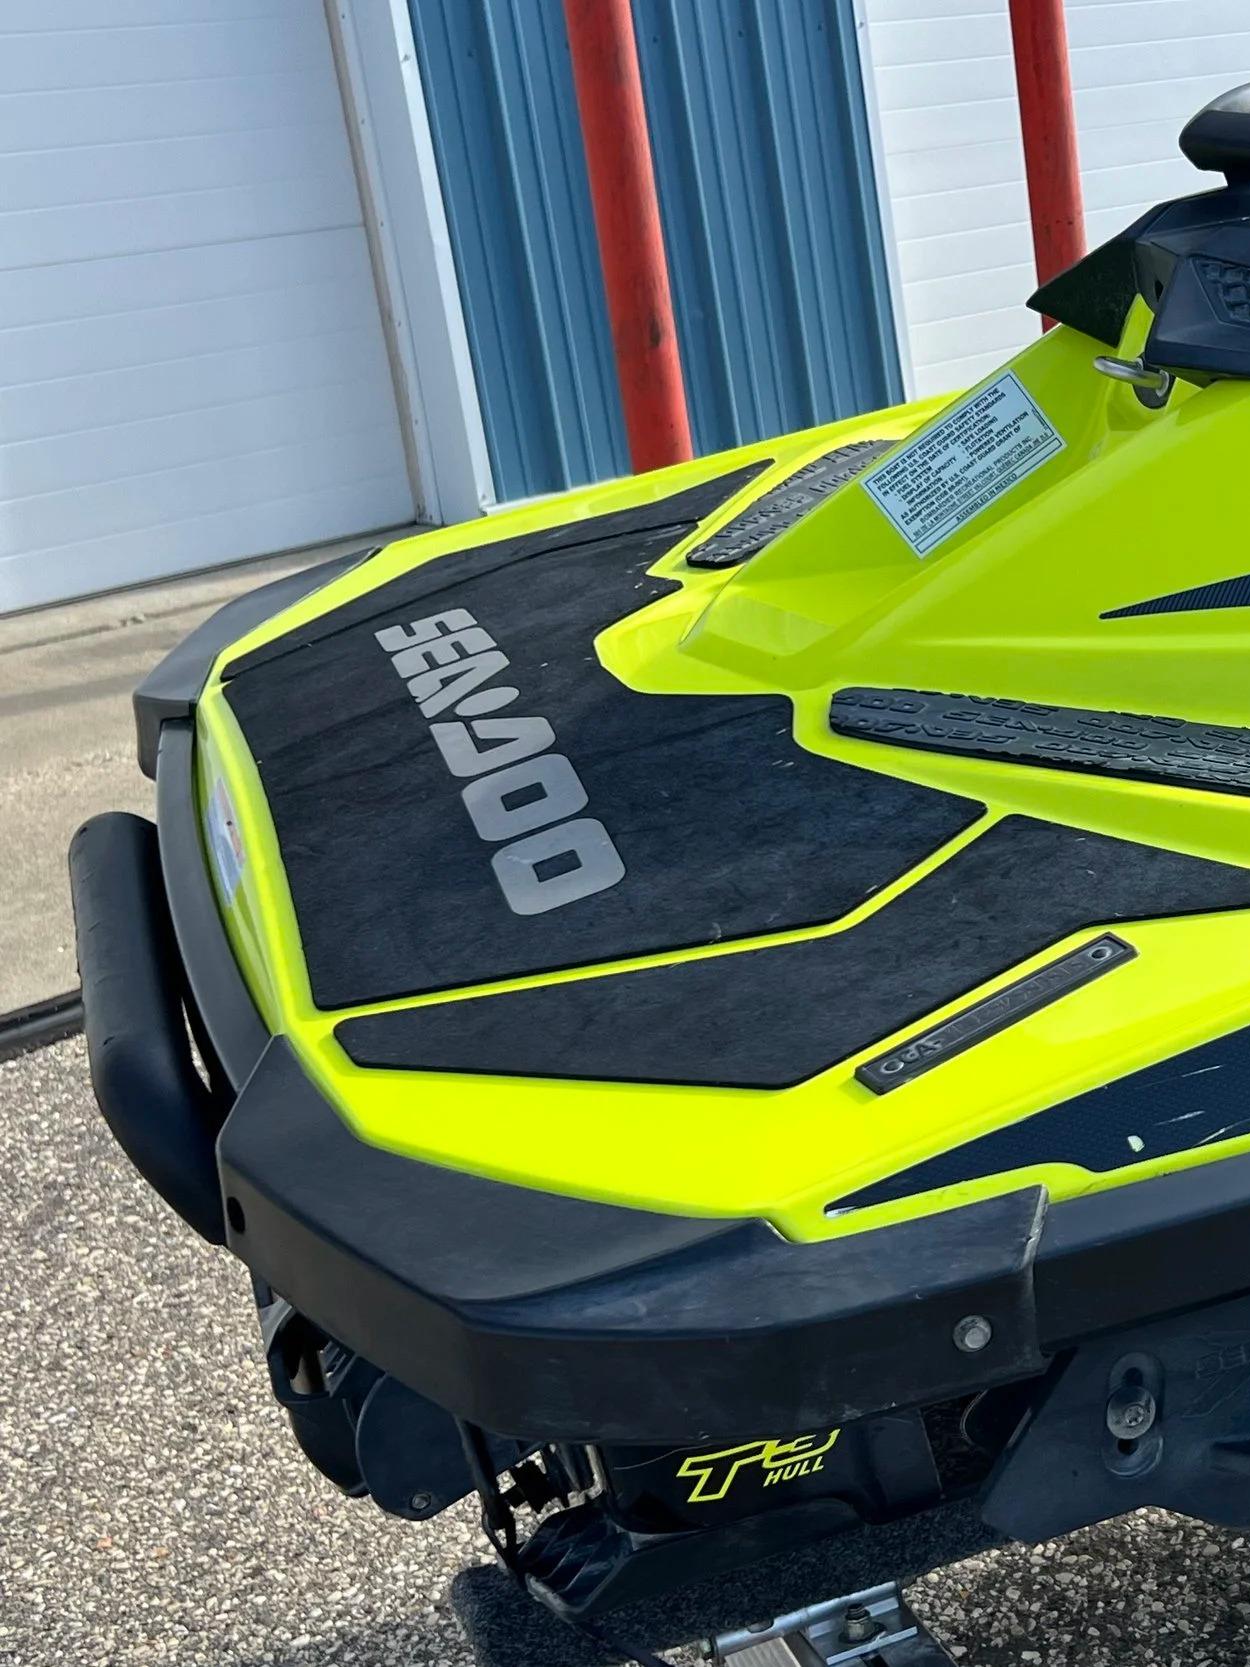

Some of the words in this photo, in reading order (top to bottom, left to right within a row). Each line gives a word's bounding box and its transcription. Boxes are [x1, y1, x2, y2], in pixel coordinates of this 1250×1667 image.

[872, 473, 886, 485] THIS
[885, 462, 900, 476] BOAT
[906, 448, 918, 460] NOT
[917, 428, 945, 451] REQUIRED
[952, 406, 974, 425] COMPLY
[973, 395, 988, 408] WITH
[987, 387, 999, 398] THE
[877, 465, 908, 491] FOLLOWING
[918, 443, 937, 460] COAST
[936, 429, 955, 446] GUARD
[954, 414, 975, 432] SAFETY
[974, 391, 1005, 416] STANDARDS
[960, 433, 975, 446] SAFE
[973, 415, 997, 435] LOADING
[964, 427, 993, 451] FLOTATION
[969, 435, 995, 457] POWERED
[994, 410, 1028, 438] VENTILATION
[888, 474, 909, 491] EFFECT
[917, 458, 929, 470] THE
[928, 448, 943, 461] DATE
[907, 485, 942, 513] AUTHORIZED
[959, 458, 977, 474] COAST
[976, 444, 996, 461] GUARD
[994, 430, 1013, 446] GRANT
[993, 442, 1022, 467] PRODUCTS
[896, 481, 911, 494] FUEL
[910, 465, 933, 484] SYSTEM
[901, 481, 924, 500] DISPLAY
[930, 456, 957, 477] CAPACITY
[906, 476, 943, 505] INFORMATION
[955, 494, 989, 522] ASSEMBLED
[994, 472, 1017, 492] MEXICO
[904, 500, 935, 525] EXEMPTION
[763, 1455, 824, 1488] HULL
